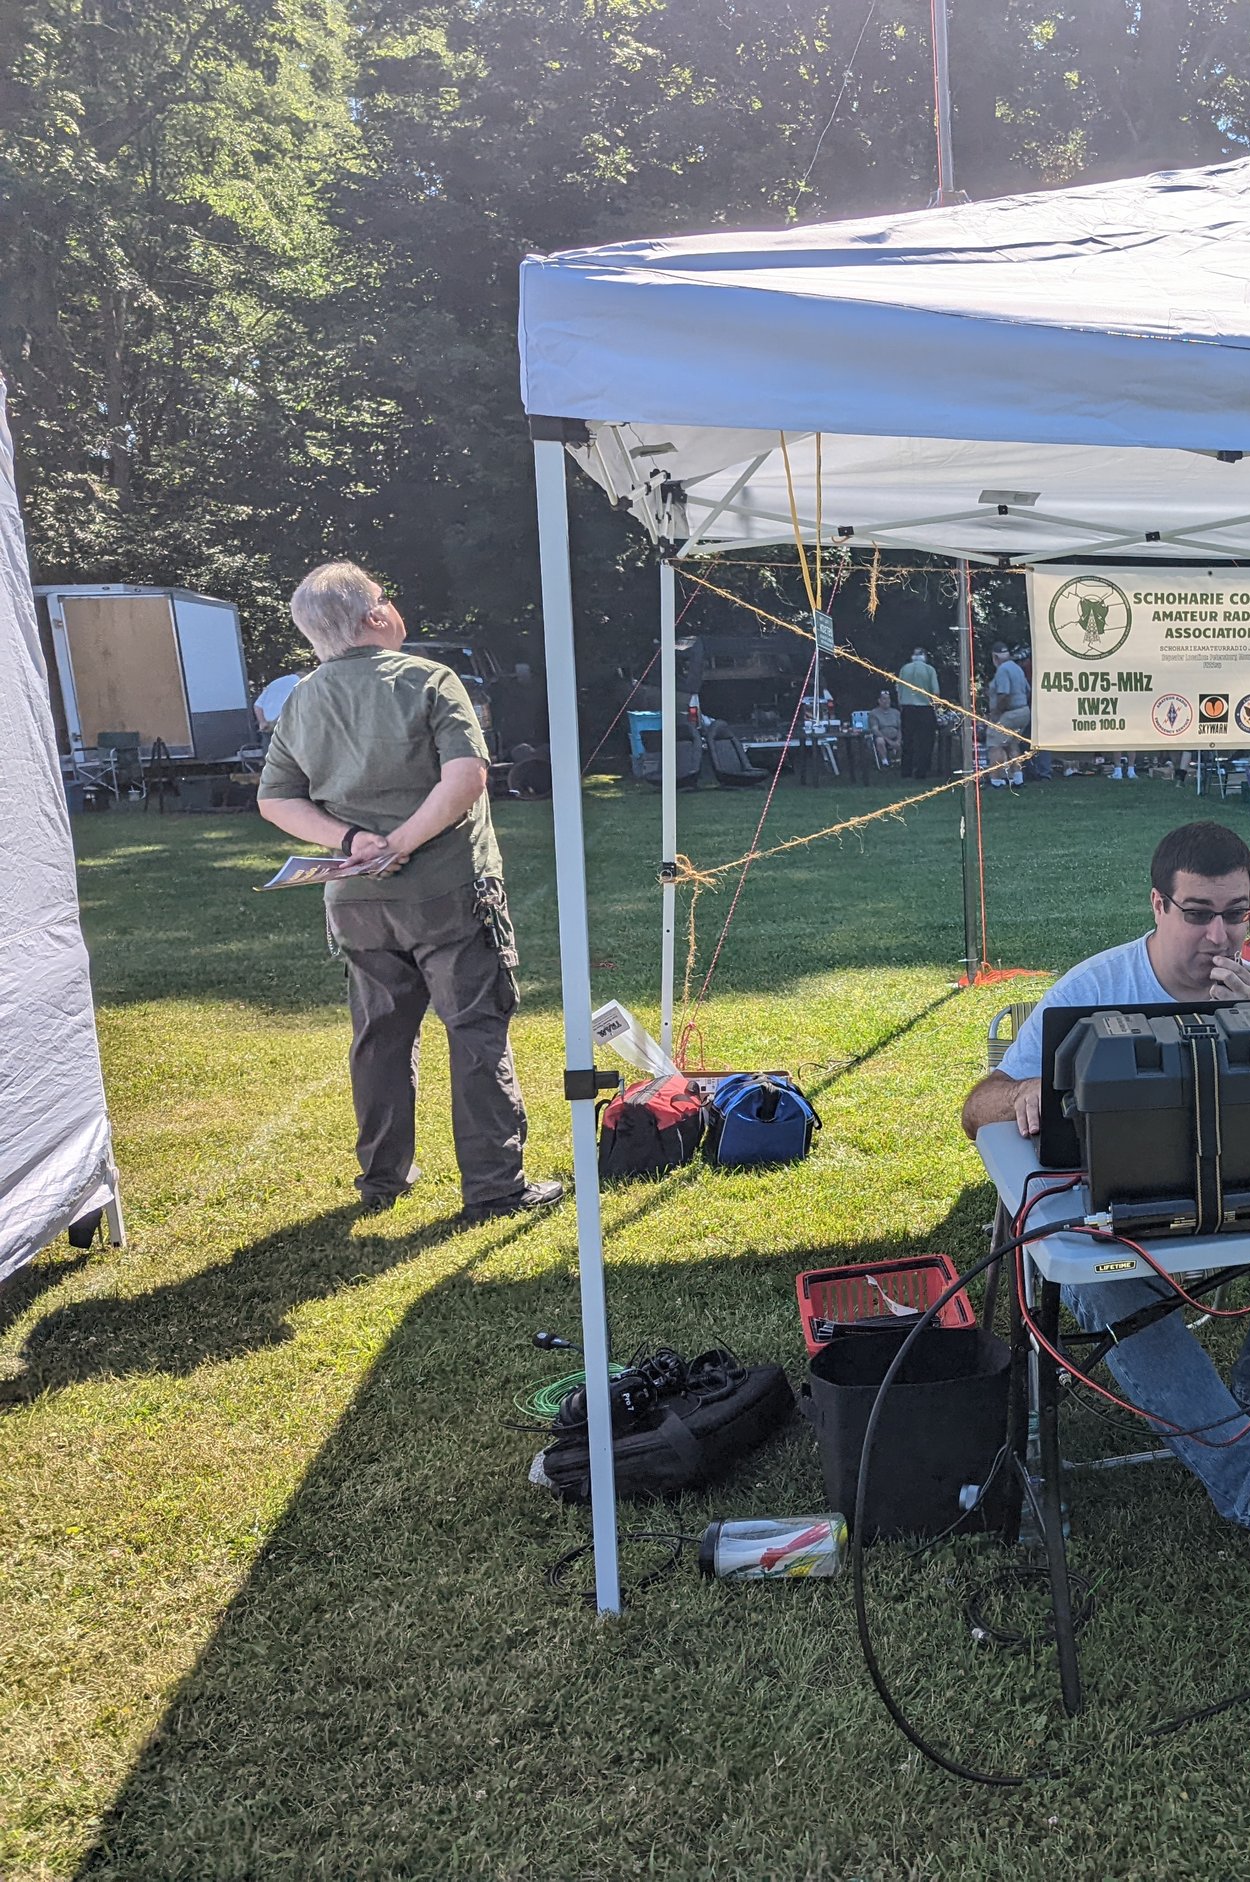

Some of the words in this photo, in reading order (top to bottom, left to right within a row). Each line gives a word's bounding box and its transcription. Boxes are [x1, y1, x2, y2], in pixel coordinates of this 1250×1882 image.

[1133, 592, 1224, 605] SCHOHARIE
[1152, 610, 1219, 622] AMATEUR
[1040, 671, 1153, 693] 445.075-MHz
[1077, 697, 1119, 716] KW2Y
[1071, 719, 1097, 732] Tone
[1098, 718, 1126, 731] 100.0
[1198, 723, 1228, 735] SKYWARN
[1099, 1261, 1132, 1272] LIFETIME
